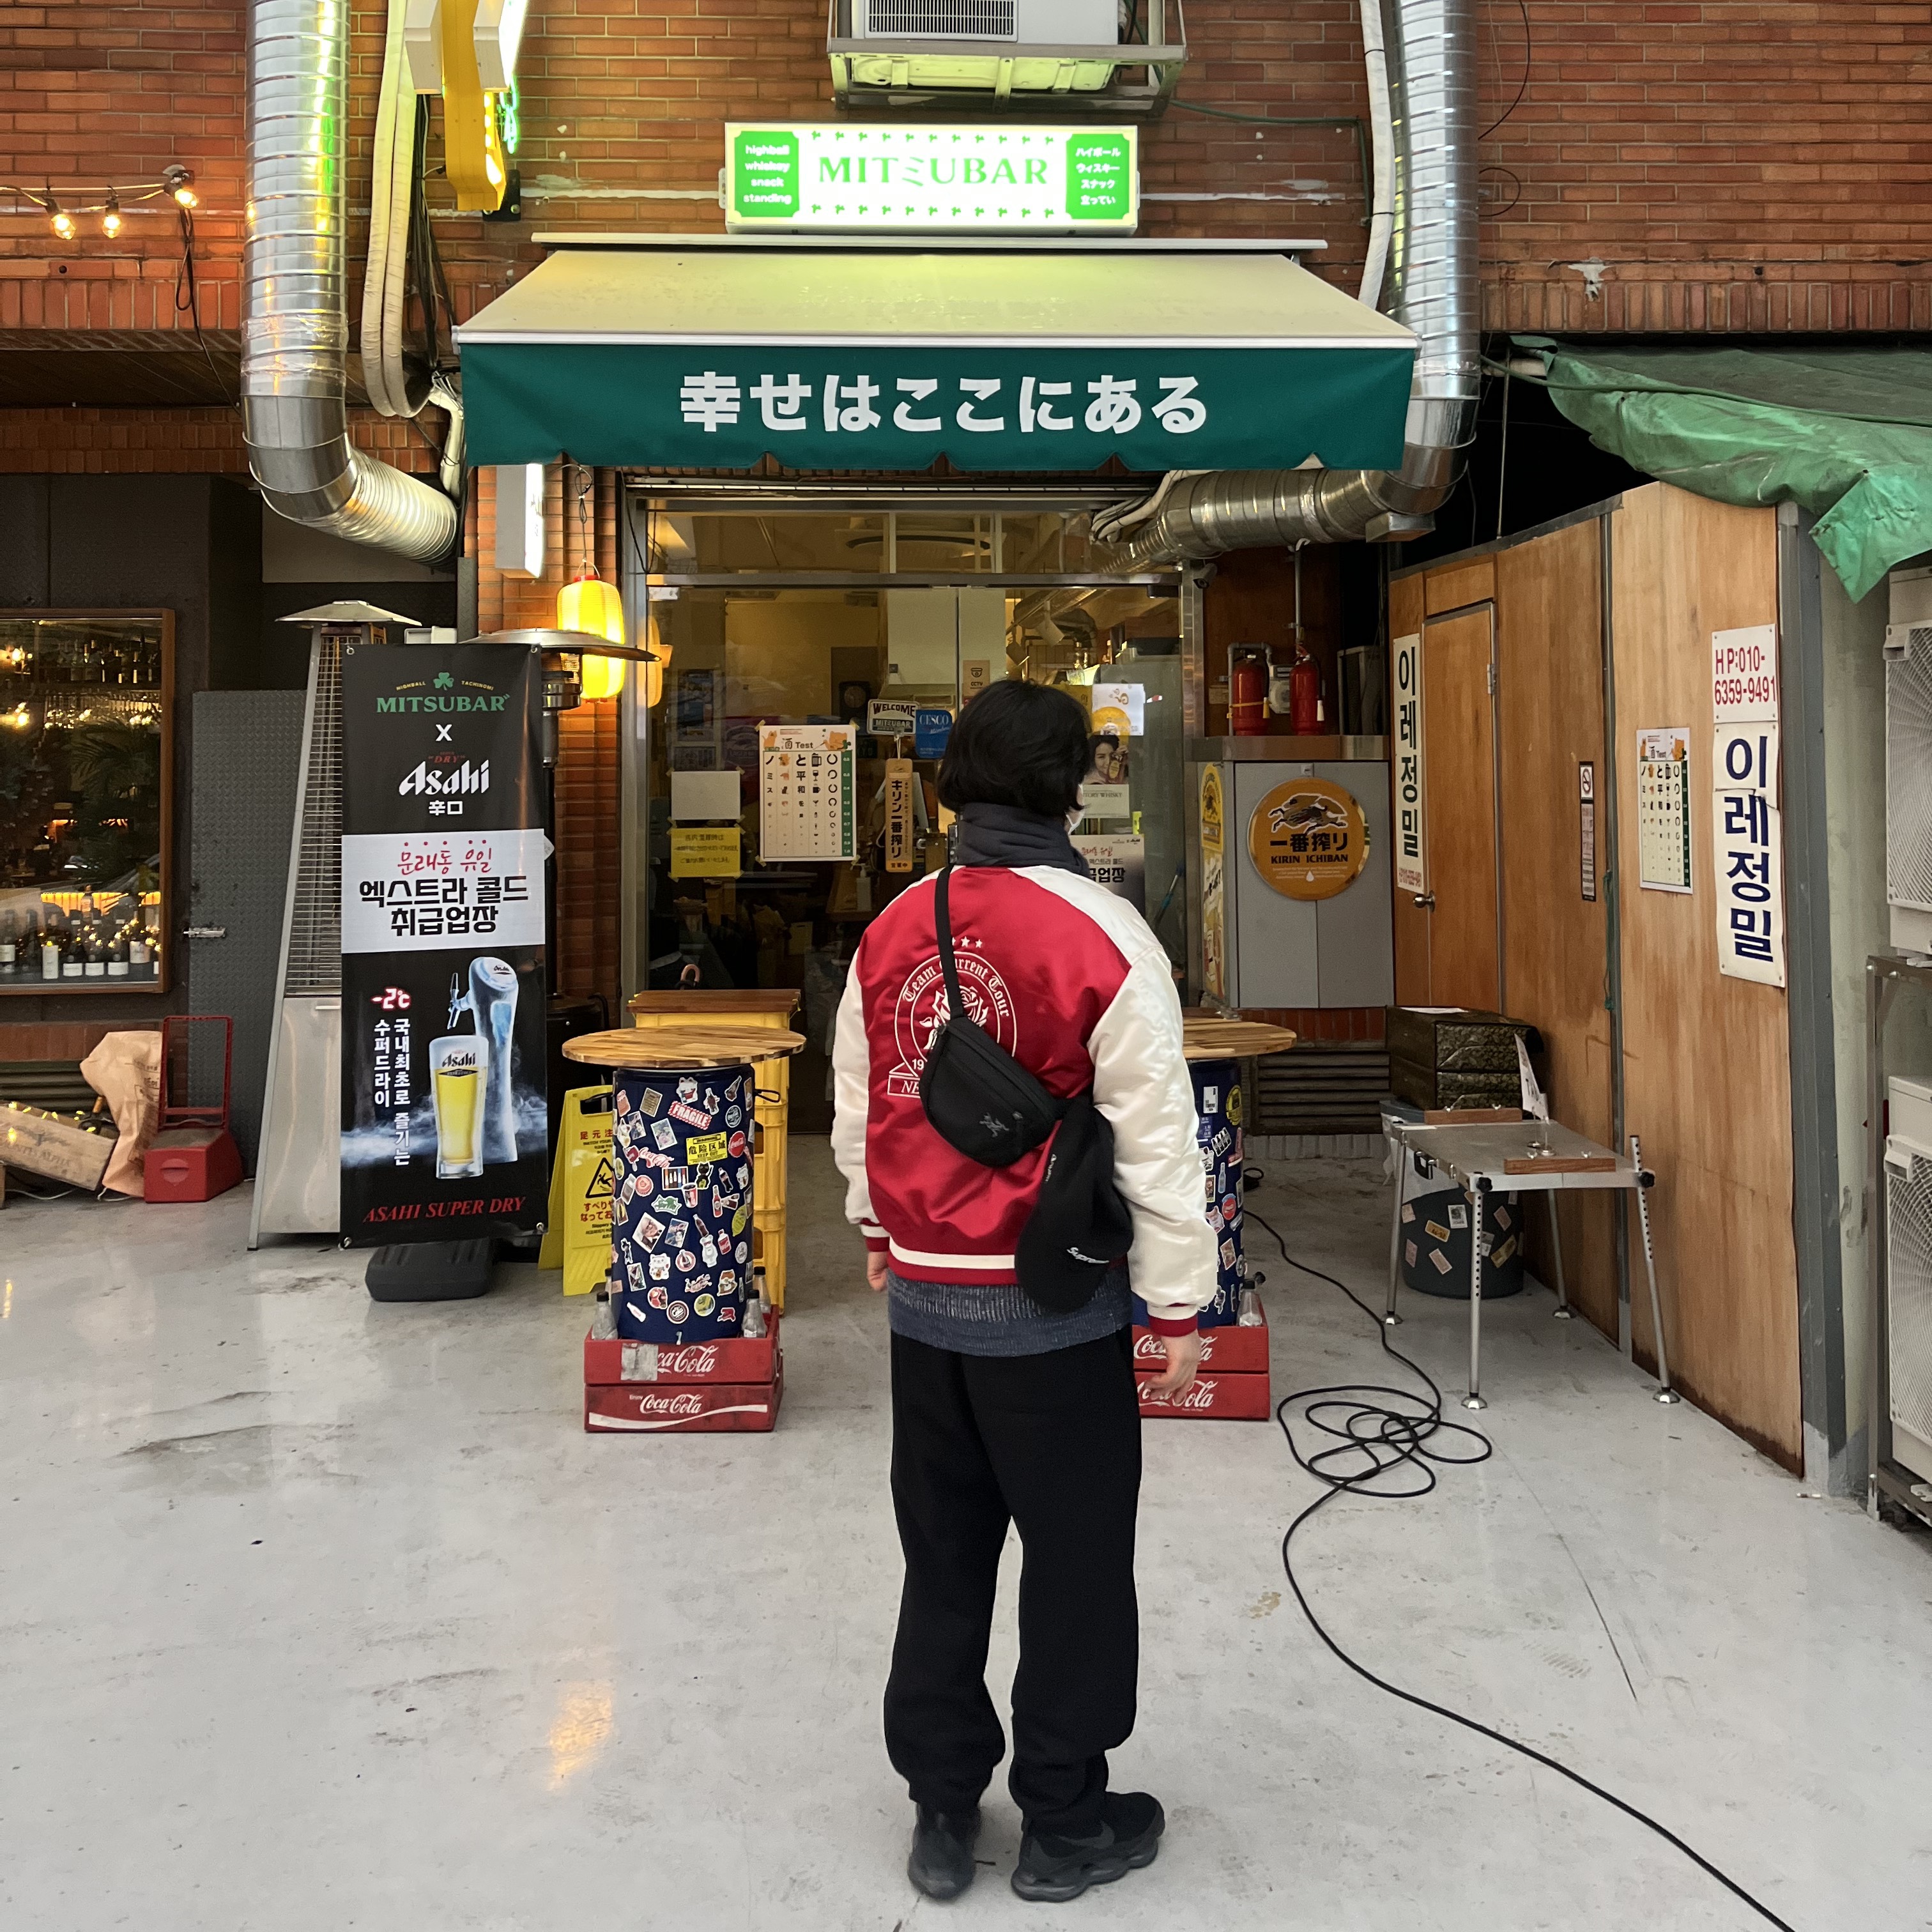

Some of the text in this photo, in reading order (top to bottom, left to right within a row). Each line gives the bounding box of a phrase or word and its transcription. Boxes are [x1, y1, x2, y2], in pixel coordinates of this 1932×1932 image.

[1075, 147, 1121, 157] ハイボール
[751, 176, 784, 187] snack
[743, 194, 792, 205] standing
[680, 371, 1207, 434] 幸せはここにある
[376, 694, 507, 713] MITSUBAR
[1715, 675, 1775, 705] 6359-9491
[873, 703, 916, 719] WELCOME
[1398, 646, 1419, 858] 이레정밀
[399, 760, 490, 796] Asahi
[429, 800, 464, 816] 辛口
[891, 780, 903, 858] キリン一番搾り
[1269, 832, 1348, 852] 一番搾り
[1724, 735, 1774, 963] 이레정밀
[397, 847, 493, 875] 문래동 유일
[1271, 854, 1349, 864] KIRIN ICHIBAN
[359, 875, 529, 908] 엑스트라 콜드
[390, 906, 499, 937] 취급업장
[901, 958, 1010, 1017] Team rrent Tour
[374, 1019, 391, 1108] 수퍼드라이
[442, 1052, 477, 1068] Asahi
[394, 1018, 411, 1167] 국내최초로 즐기는
[673, 1103, 710, 1127] FRAGILE
[580, 1128, 613, 1140] 足元注
[362, 1196, 526, 1223] ASAHI SUPER DRY
[657, 1345, 719, 1374] ca-Cola
[640, 1393, 705, 1414] Coca-Cola
